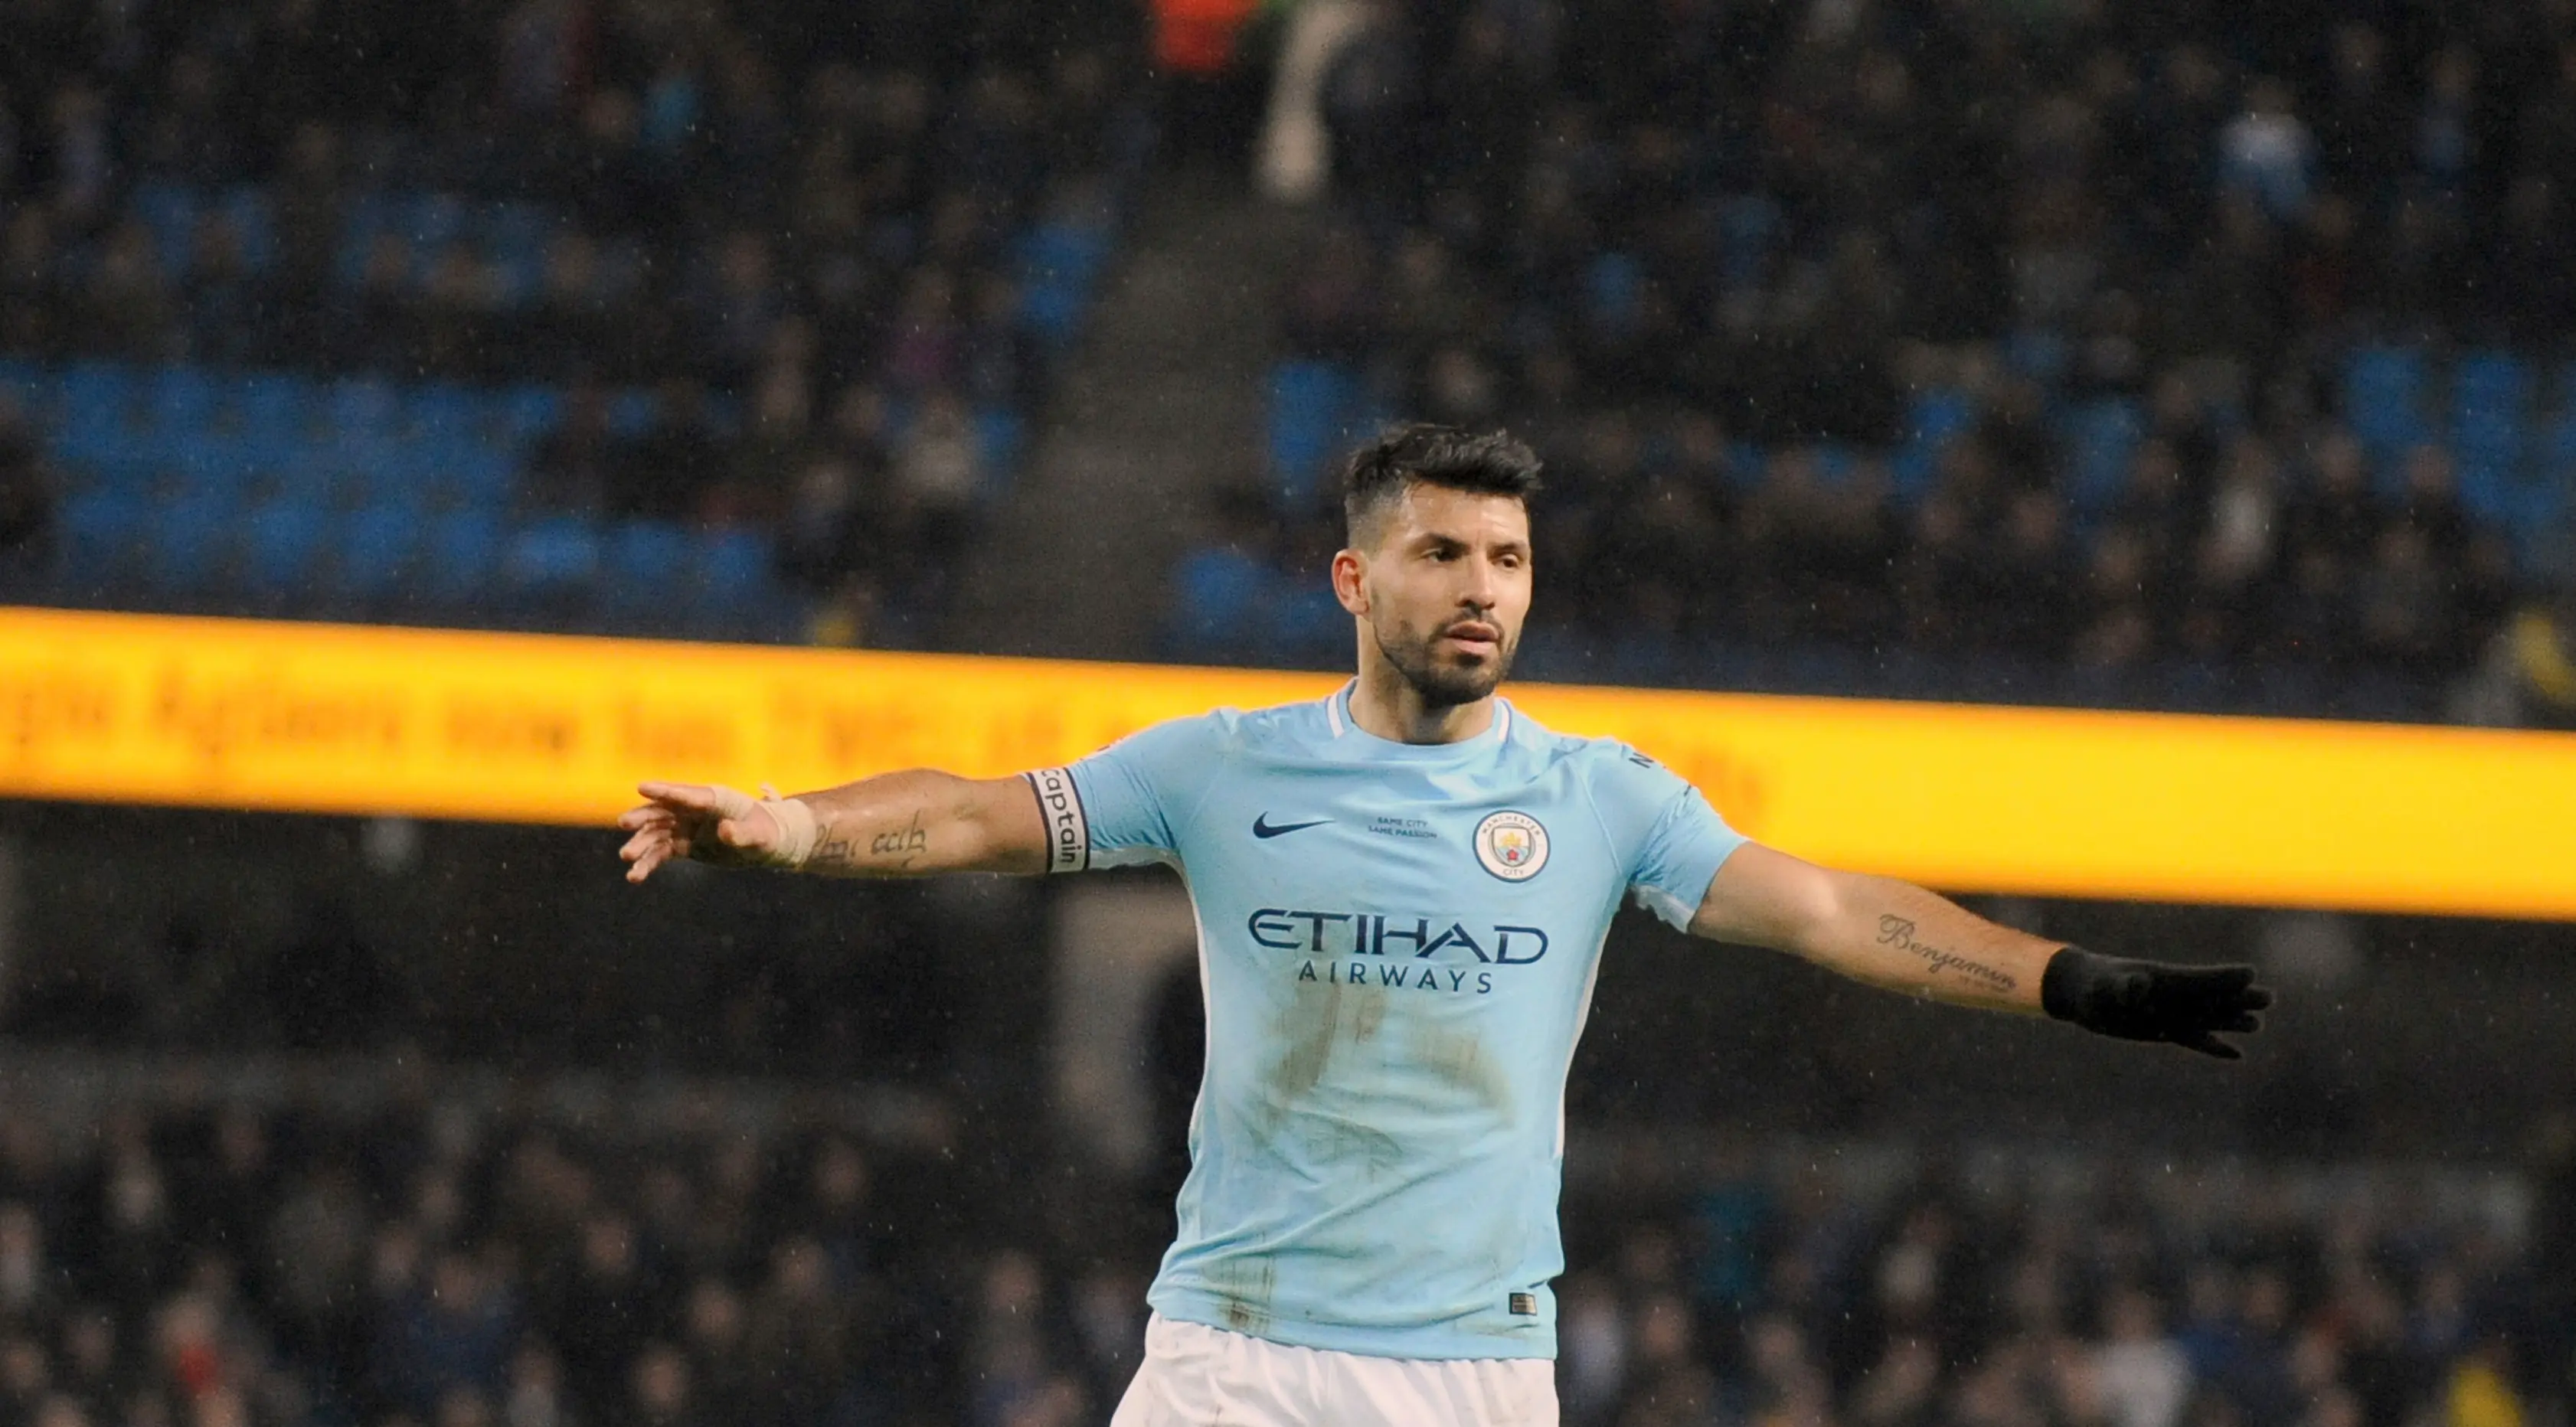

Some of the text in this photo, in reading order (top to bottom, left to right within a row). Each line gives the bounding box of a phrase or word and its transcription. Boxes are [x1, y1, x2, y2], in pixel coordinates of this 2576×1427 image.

[1041, 769, 1083, 864] captain
[1406, 819, 1428, 828] CITY
[1502, 868, 1524, 877] CITY
[1248, 908, 1548, 965] ETIHAD
[1877, 913, 2017, 990] Benjamin
[1298, 960, 1492, 994] AIRWAYS
